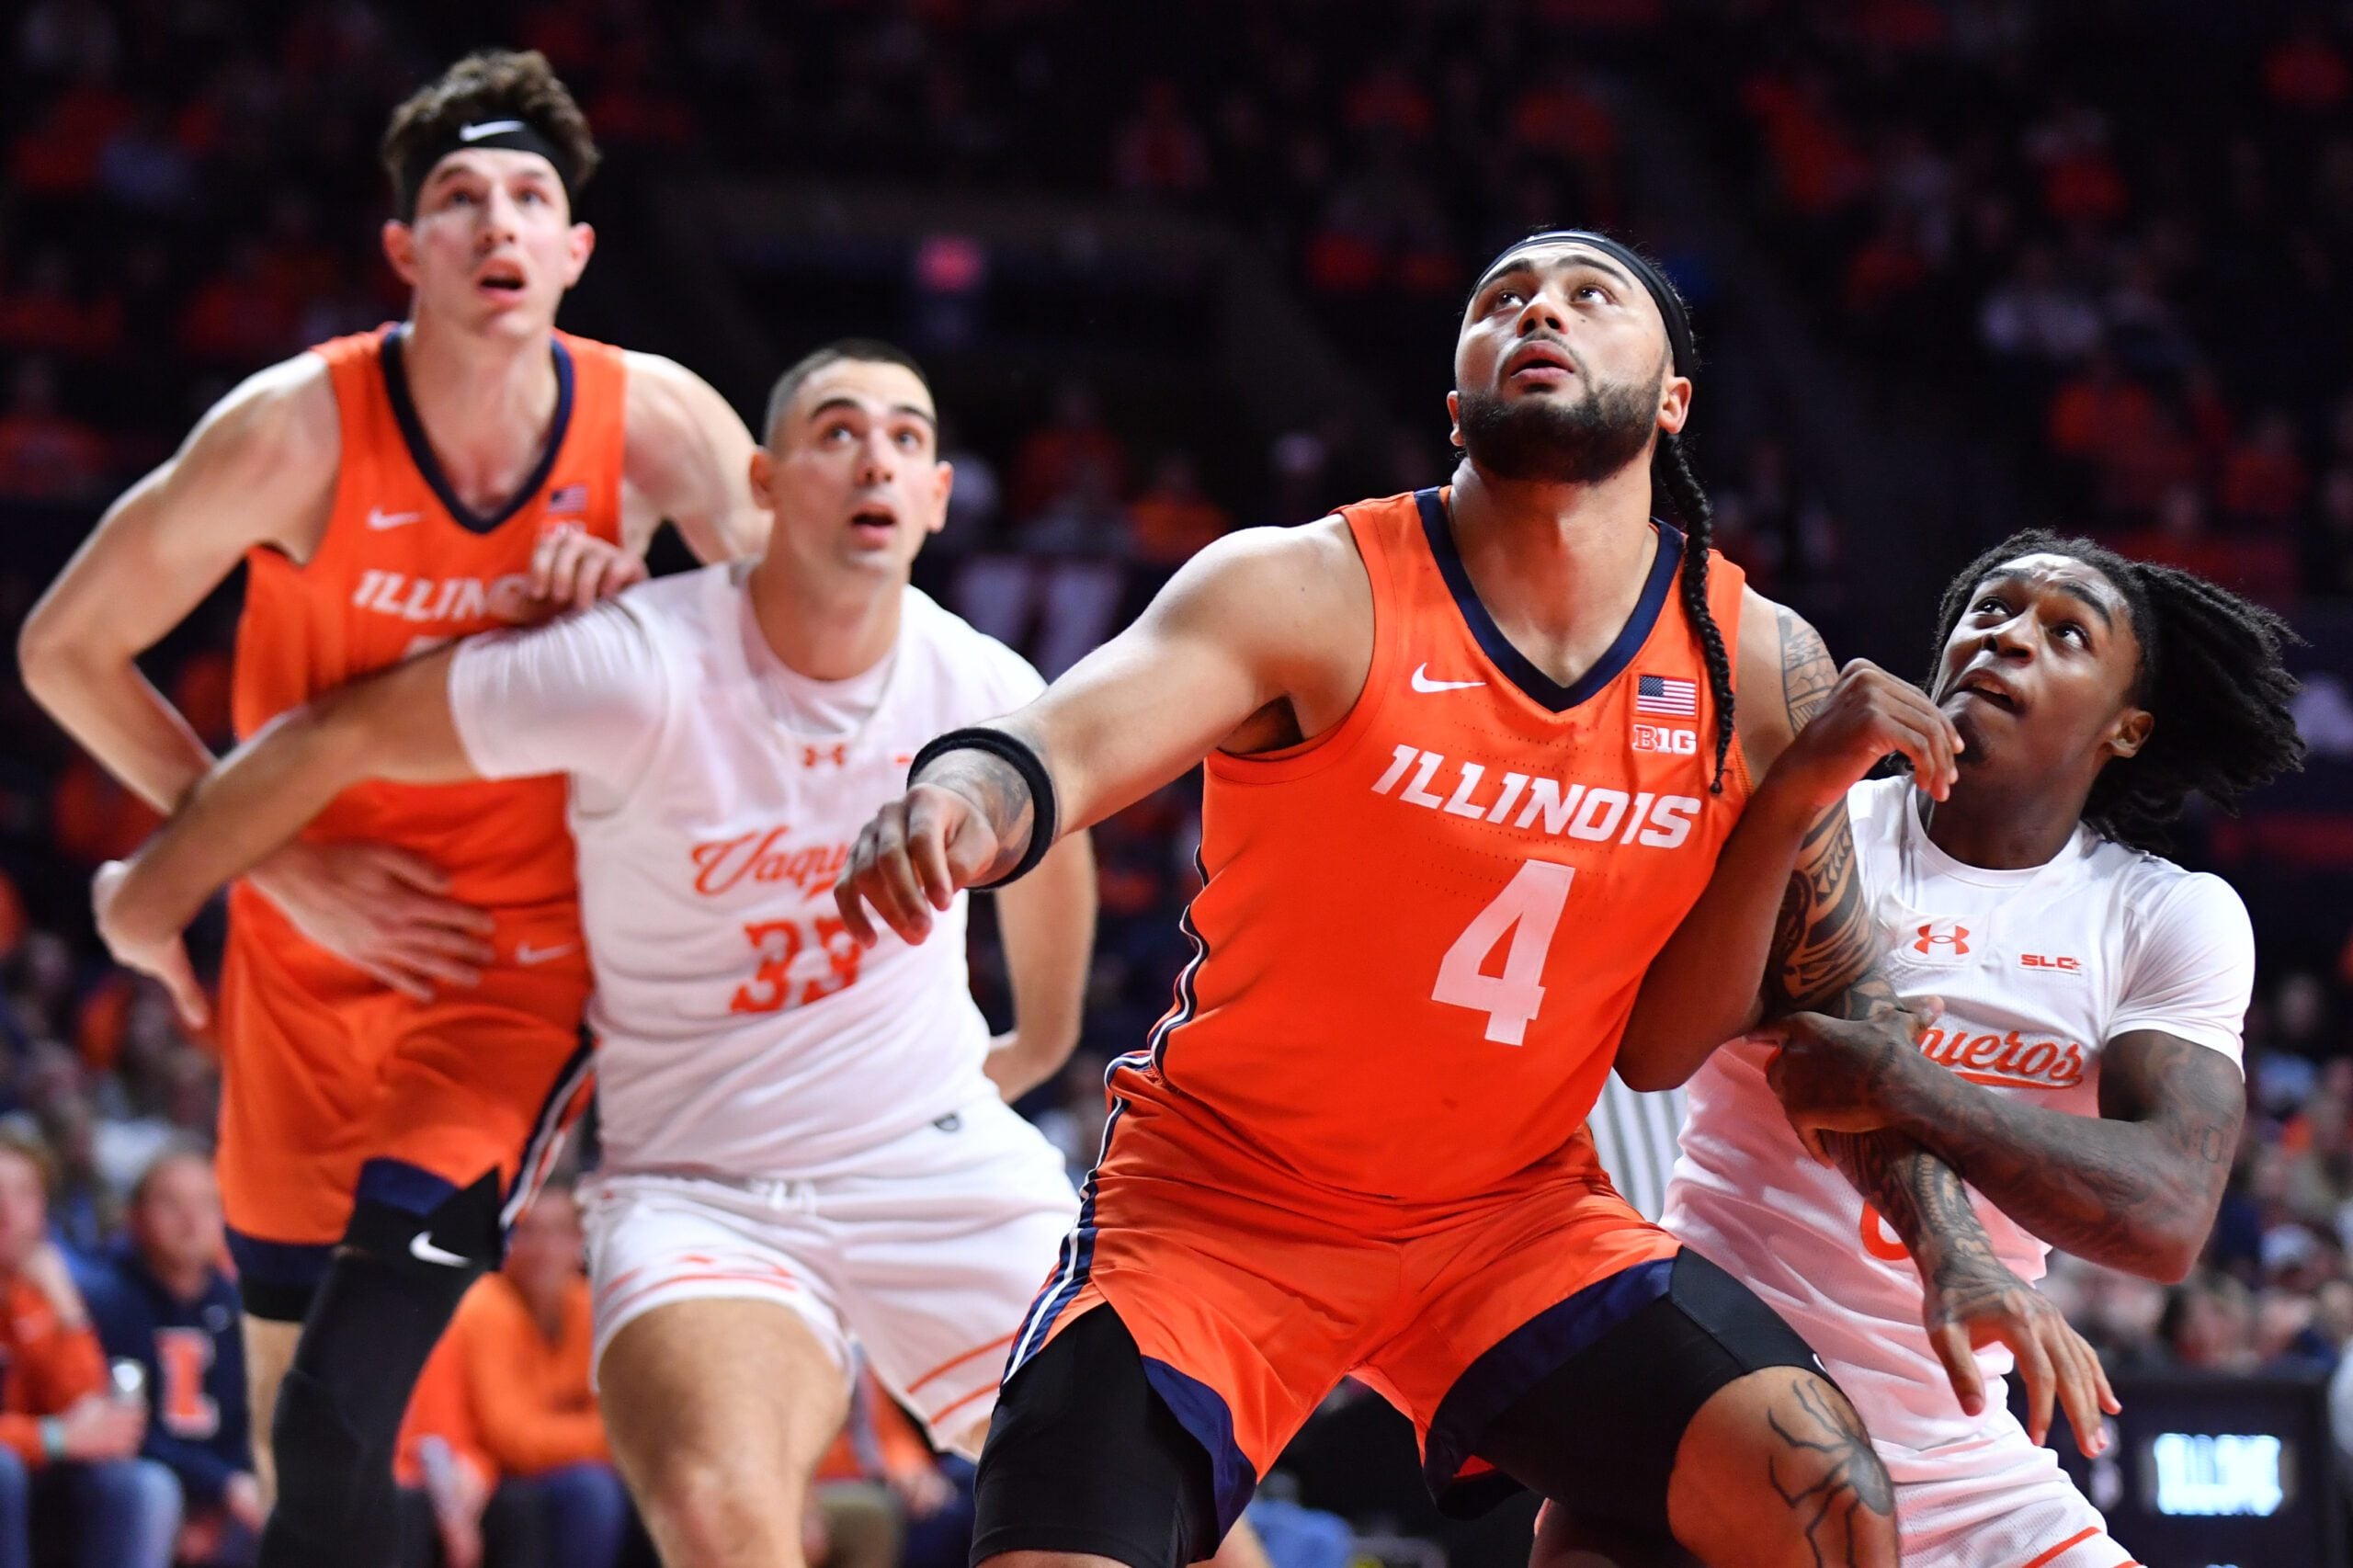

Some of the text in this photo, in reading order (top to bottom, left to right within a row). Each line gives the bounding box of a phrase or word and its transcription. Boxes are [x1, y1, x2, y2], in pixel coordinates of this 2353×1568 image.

[353, 569, 485, 622] ILLIN
[1370, 744, 1701, 848] ILLINOIS
[691, 824, 849, 896] Vaqu
[1431, 858, 1576, 1046] 4
[1916, 1028, 2084, 1088] ueros
